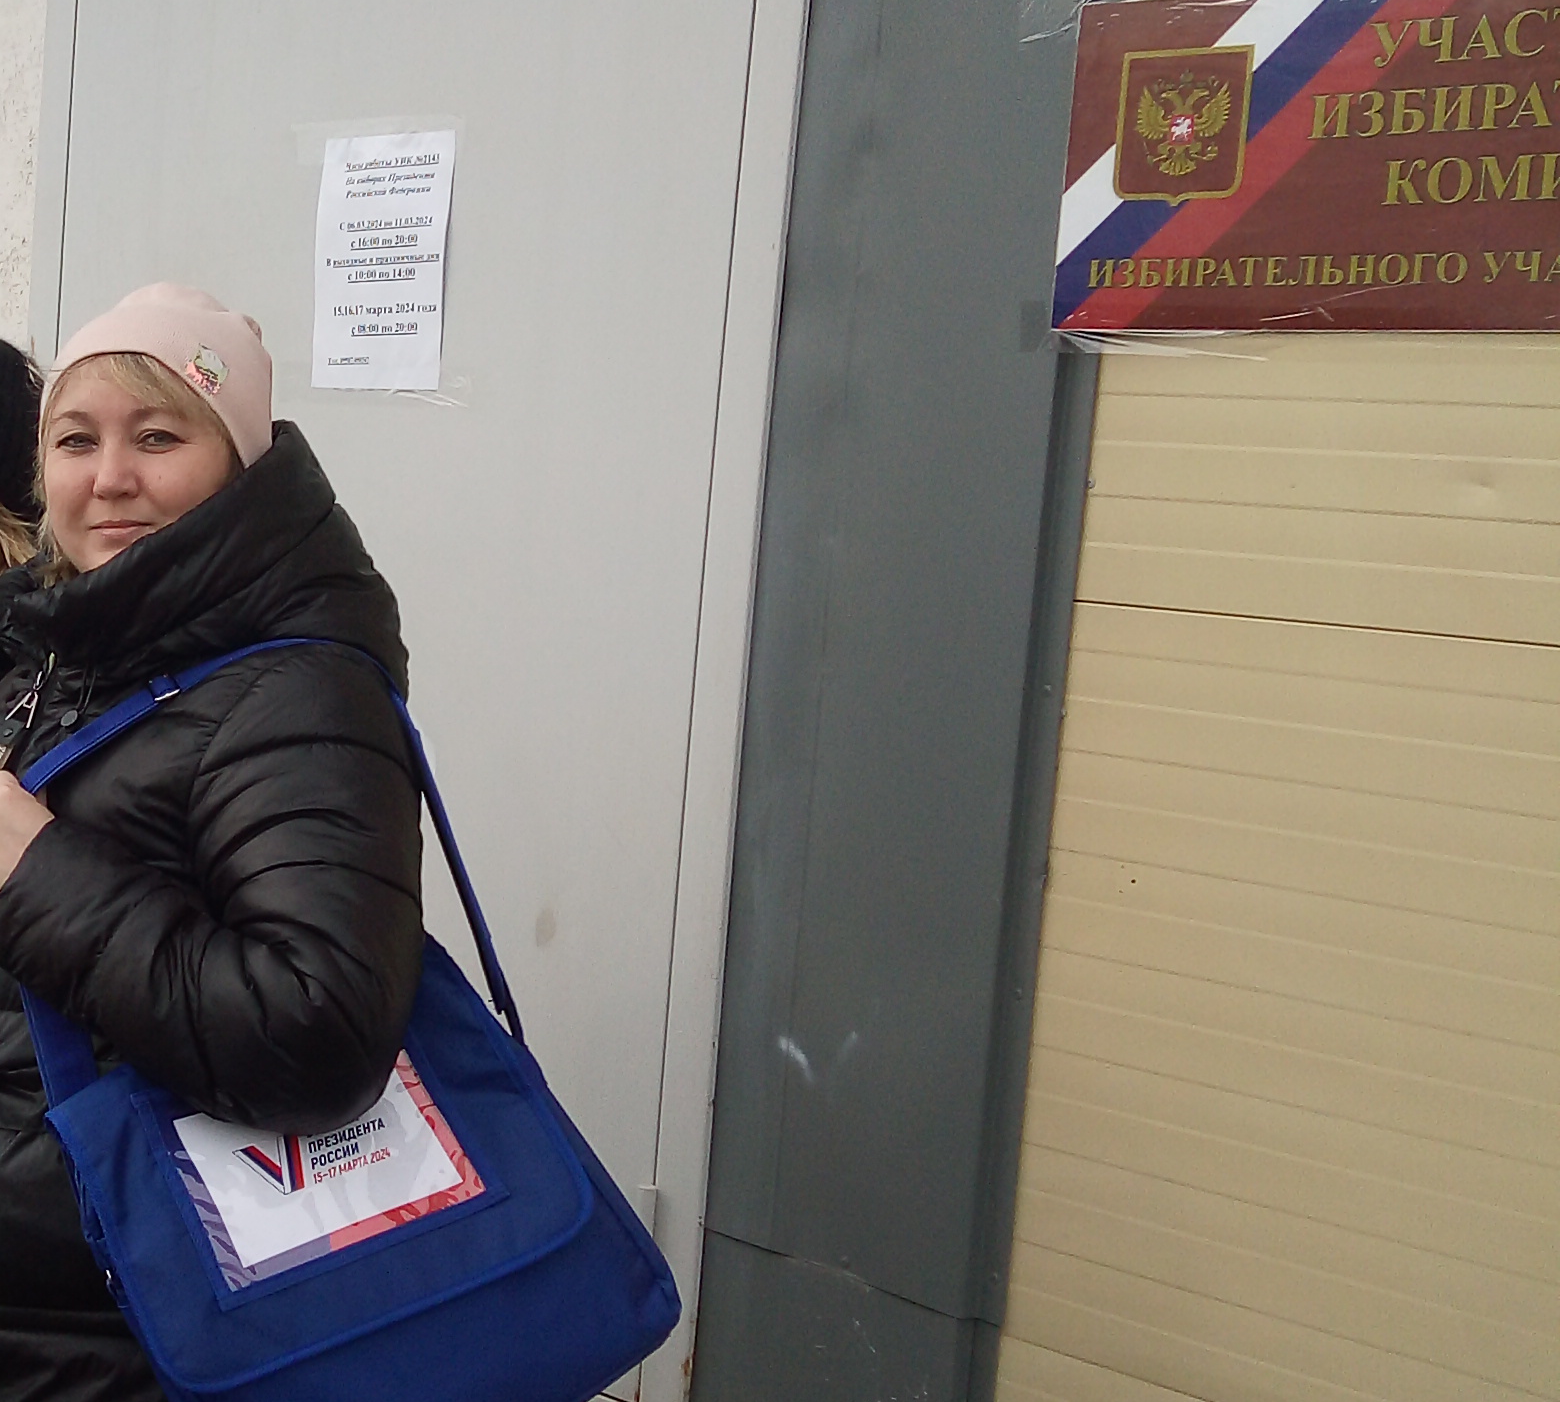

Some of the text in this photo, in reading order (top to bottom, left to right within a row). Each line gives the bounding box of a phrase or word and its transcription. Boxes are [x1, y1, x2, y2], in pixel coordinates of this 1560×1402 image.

[1370, 8, 1560, 68] УЧАС
[1308, 80, 1560, 140] ИЗБИРА
[358, 237, 380, 248] 16:00
[382, 238, 393, 247] по
[395, 234, 418, 245] 20:00
[355, 269, 377, 280] 10:00
[378, 270, 390, 279] по
[392, 267, 416, 278] 14:00
[1087, 252, 1469, 288] ИЗБИРАТЕЛЬНОГО
[395, 302, 415, 314] 2024
[395, 322, 418, 332] 20:00
[308, 1118, 386, 1154] ПРЕЗИДЕНТА
[310, 1141, 360, 1170] РОССИИ
[338, 1154, 369, 1176] МАРТА
[370, 1146, 391, 1164] 2024
